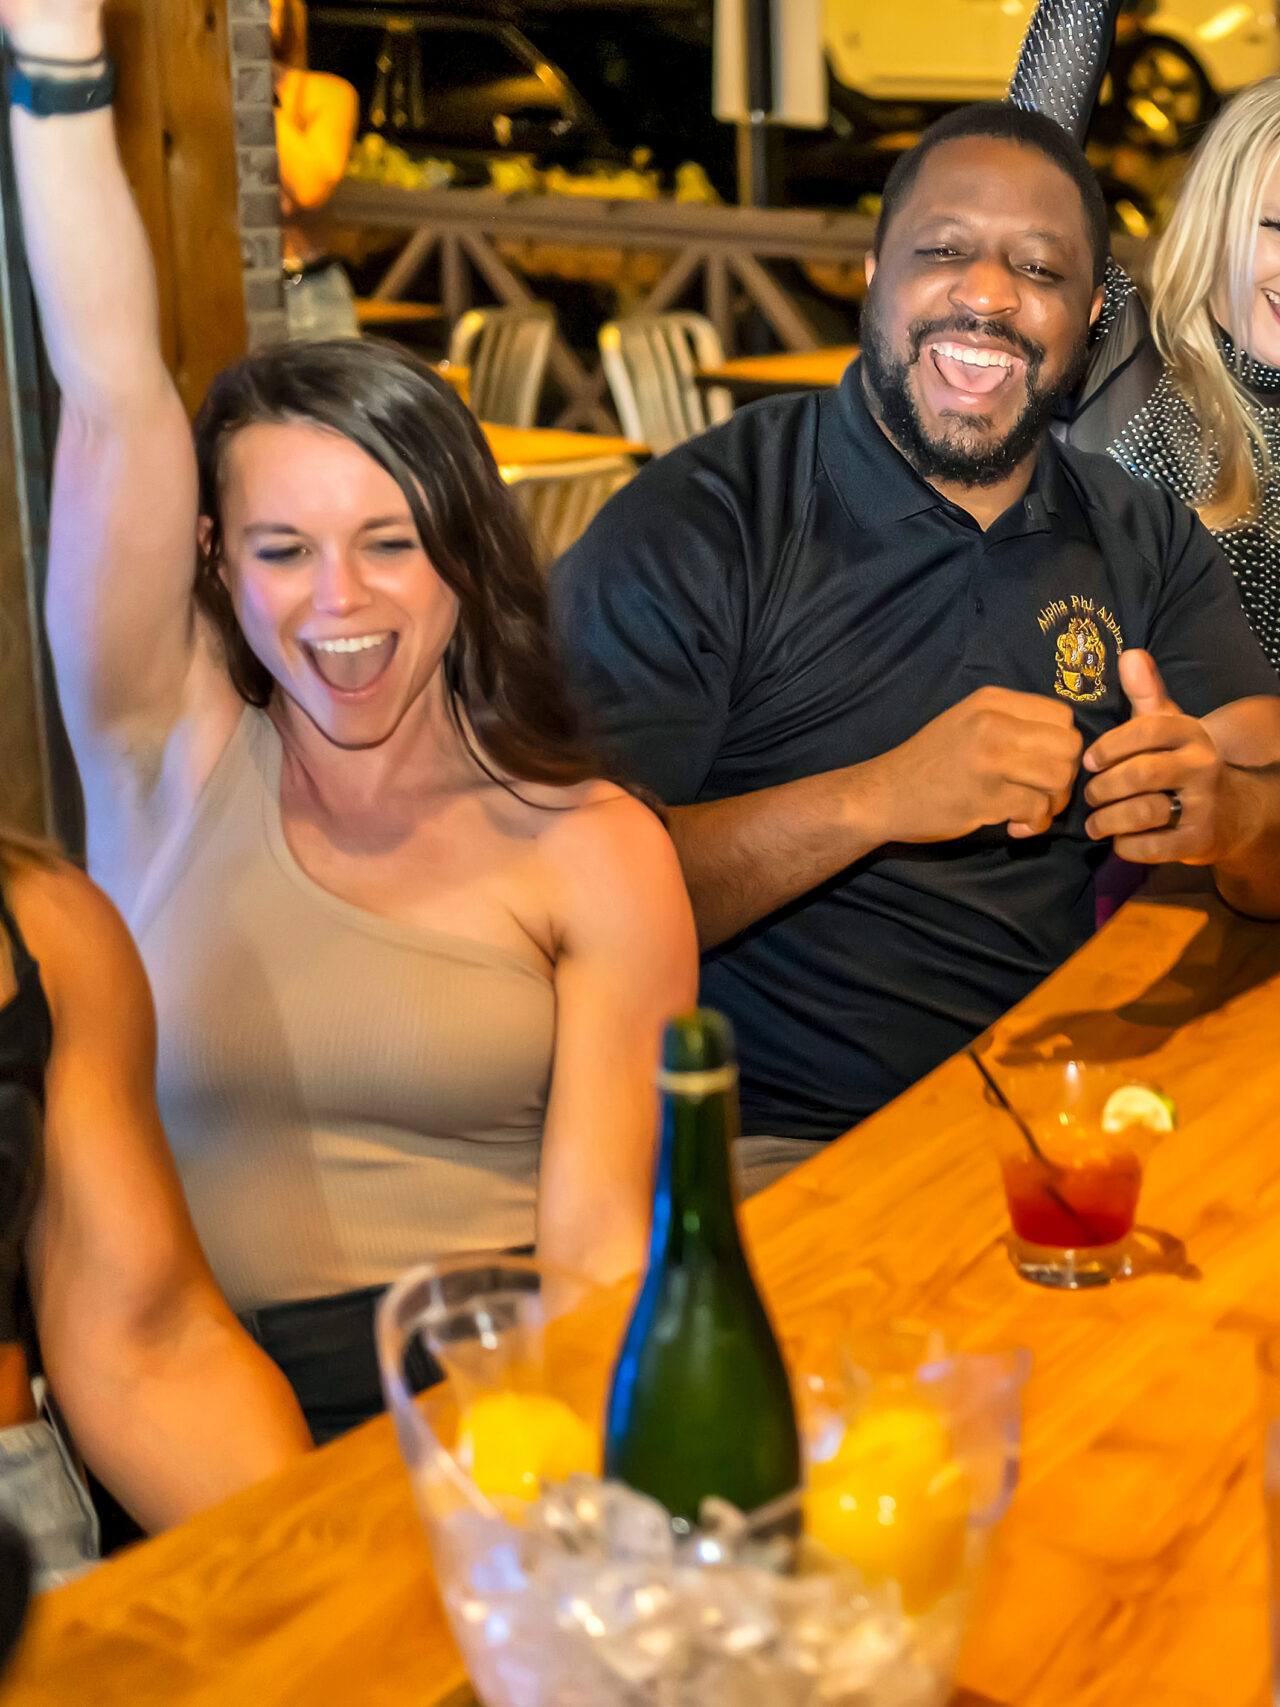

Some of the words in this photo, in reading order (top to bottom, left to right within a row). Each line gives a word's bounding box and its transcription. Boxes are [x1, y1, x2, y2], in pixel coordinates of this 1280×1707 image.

[1036, 600, 1068, 635] Alpha
[1070, 594, 1095, 611] Phi
[1096, 606, 1123, 644] Alpha
